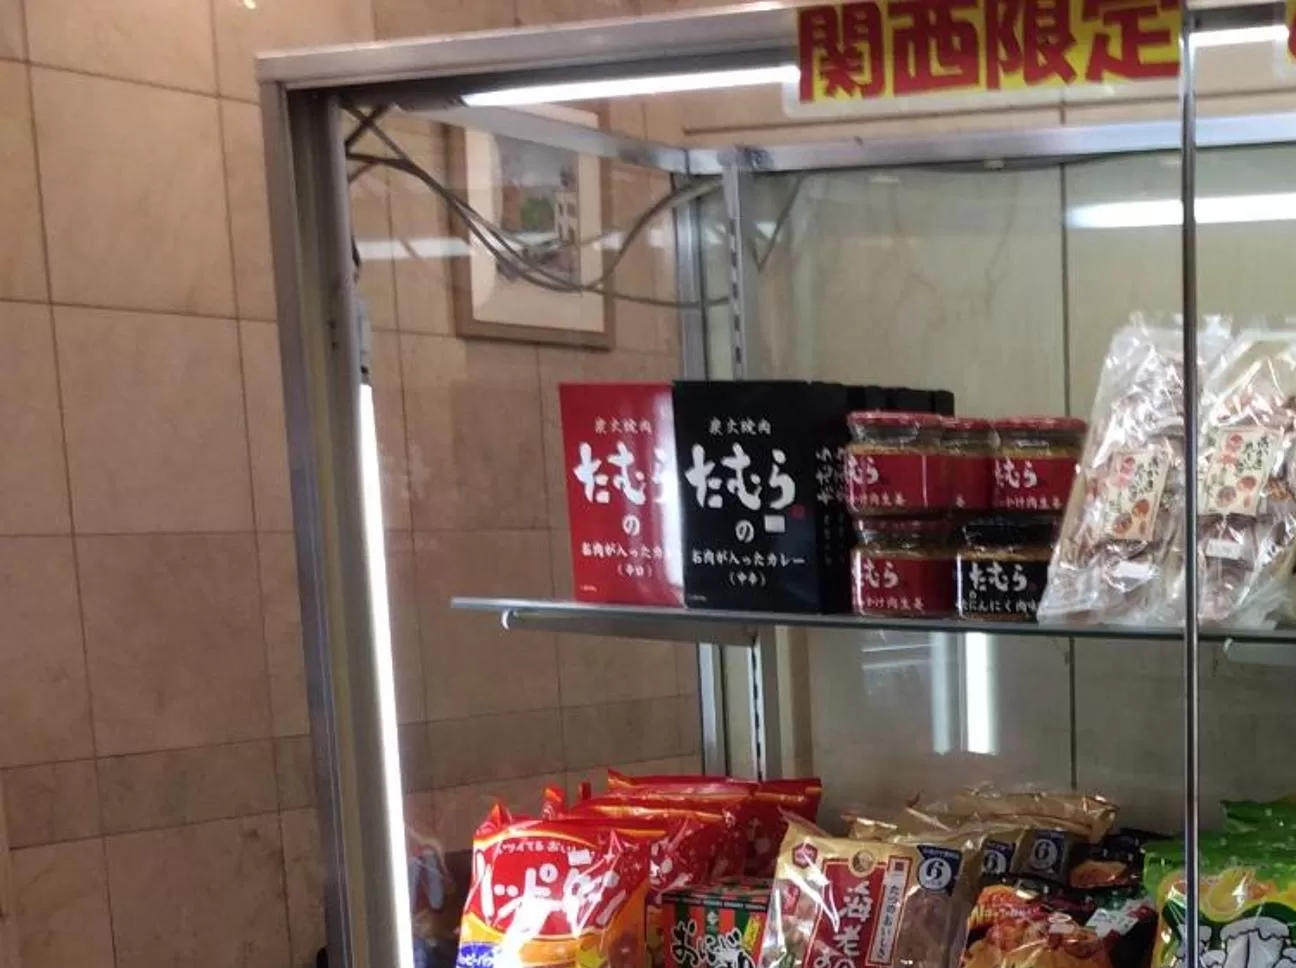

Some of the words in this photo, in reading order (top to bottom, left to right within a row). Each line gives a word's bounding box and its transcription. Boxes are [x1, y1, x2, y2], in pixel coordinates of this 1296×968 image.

[796, 0, 1180, 101] 関西限定
[686, 443, 796, 511] たむら
[623, 515, 640, 536] の
[735, 520, 755, 543] の
